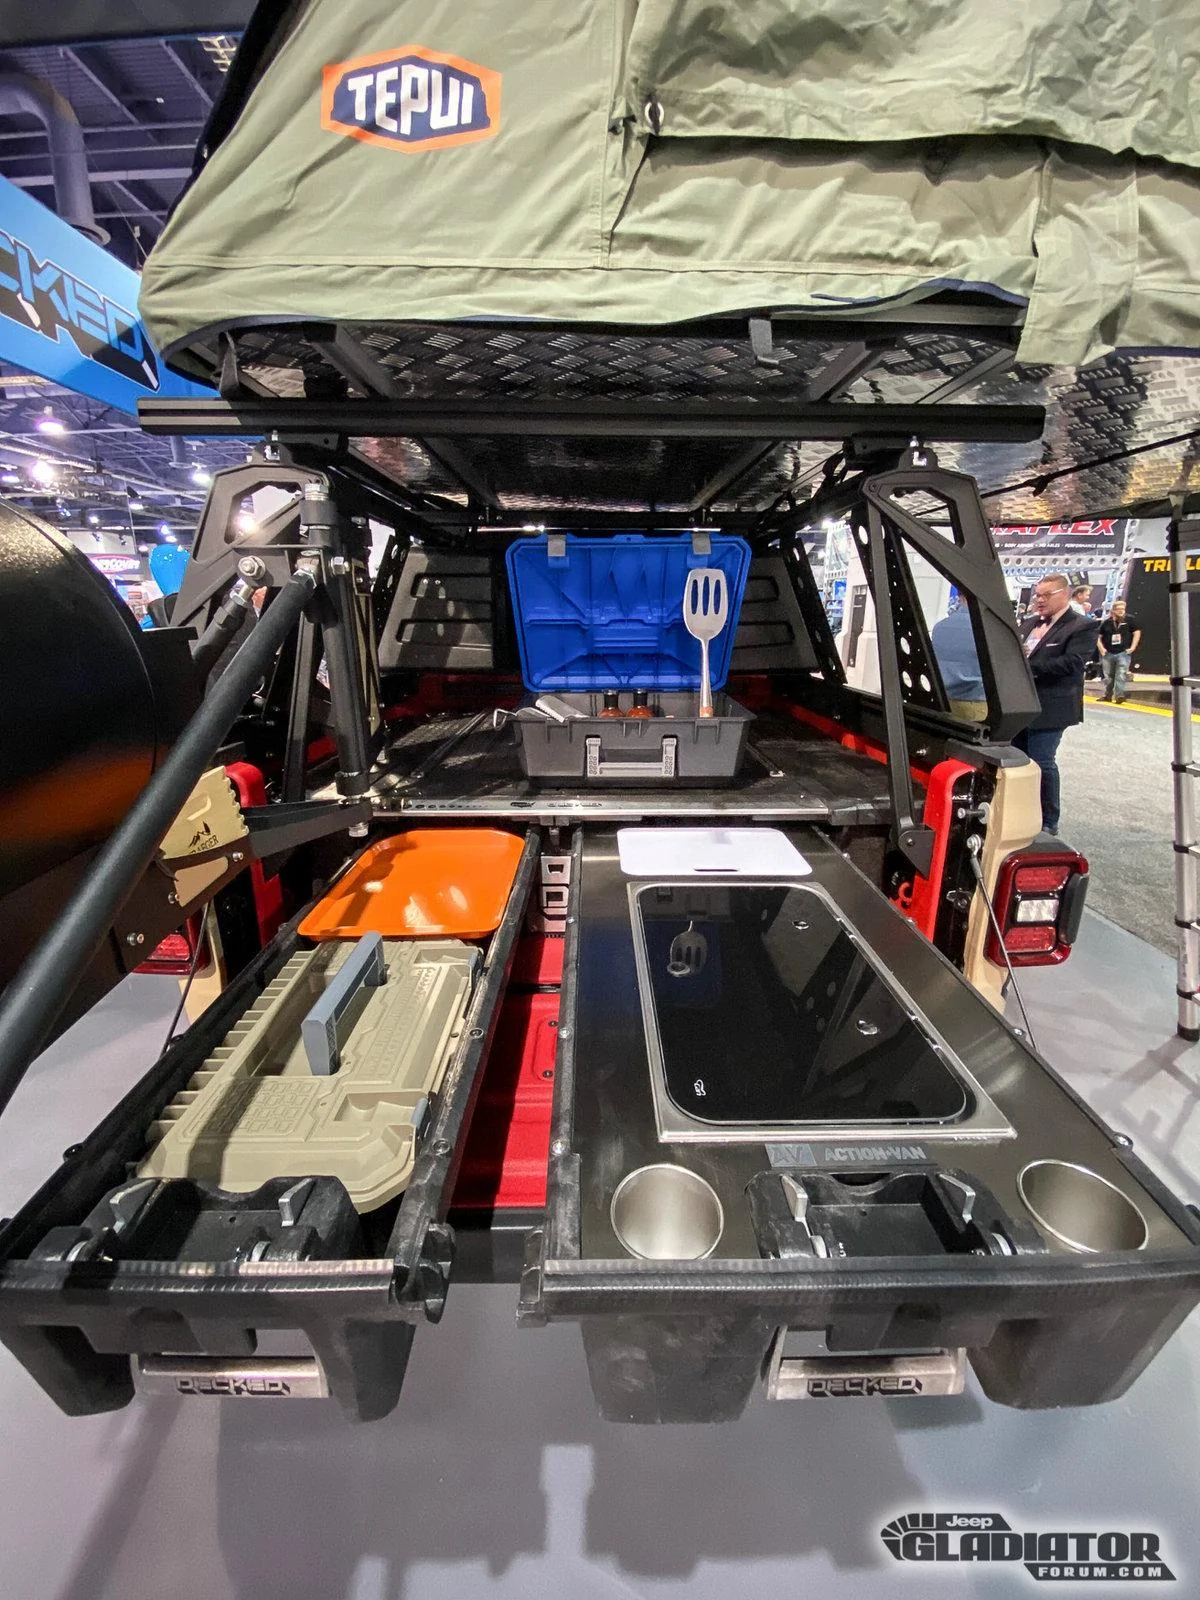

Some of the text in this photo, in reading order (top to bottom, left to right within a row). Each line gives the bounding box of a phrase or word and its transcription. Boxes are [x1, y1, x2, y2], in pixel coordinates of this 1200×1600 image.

[347, 64, 474, 136] TEPUI
[175, 1377, 290, 1395] DECKED
[807, 1375, 922, 1397] DECKED
